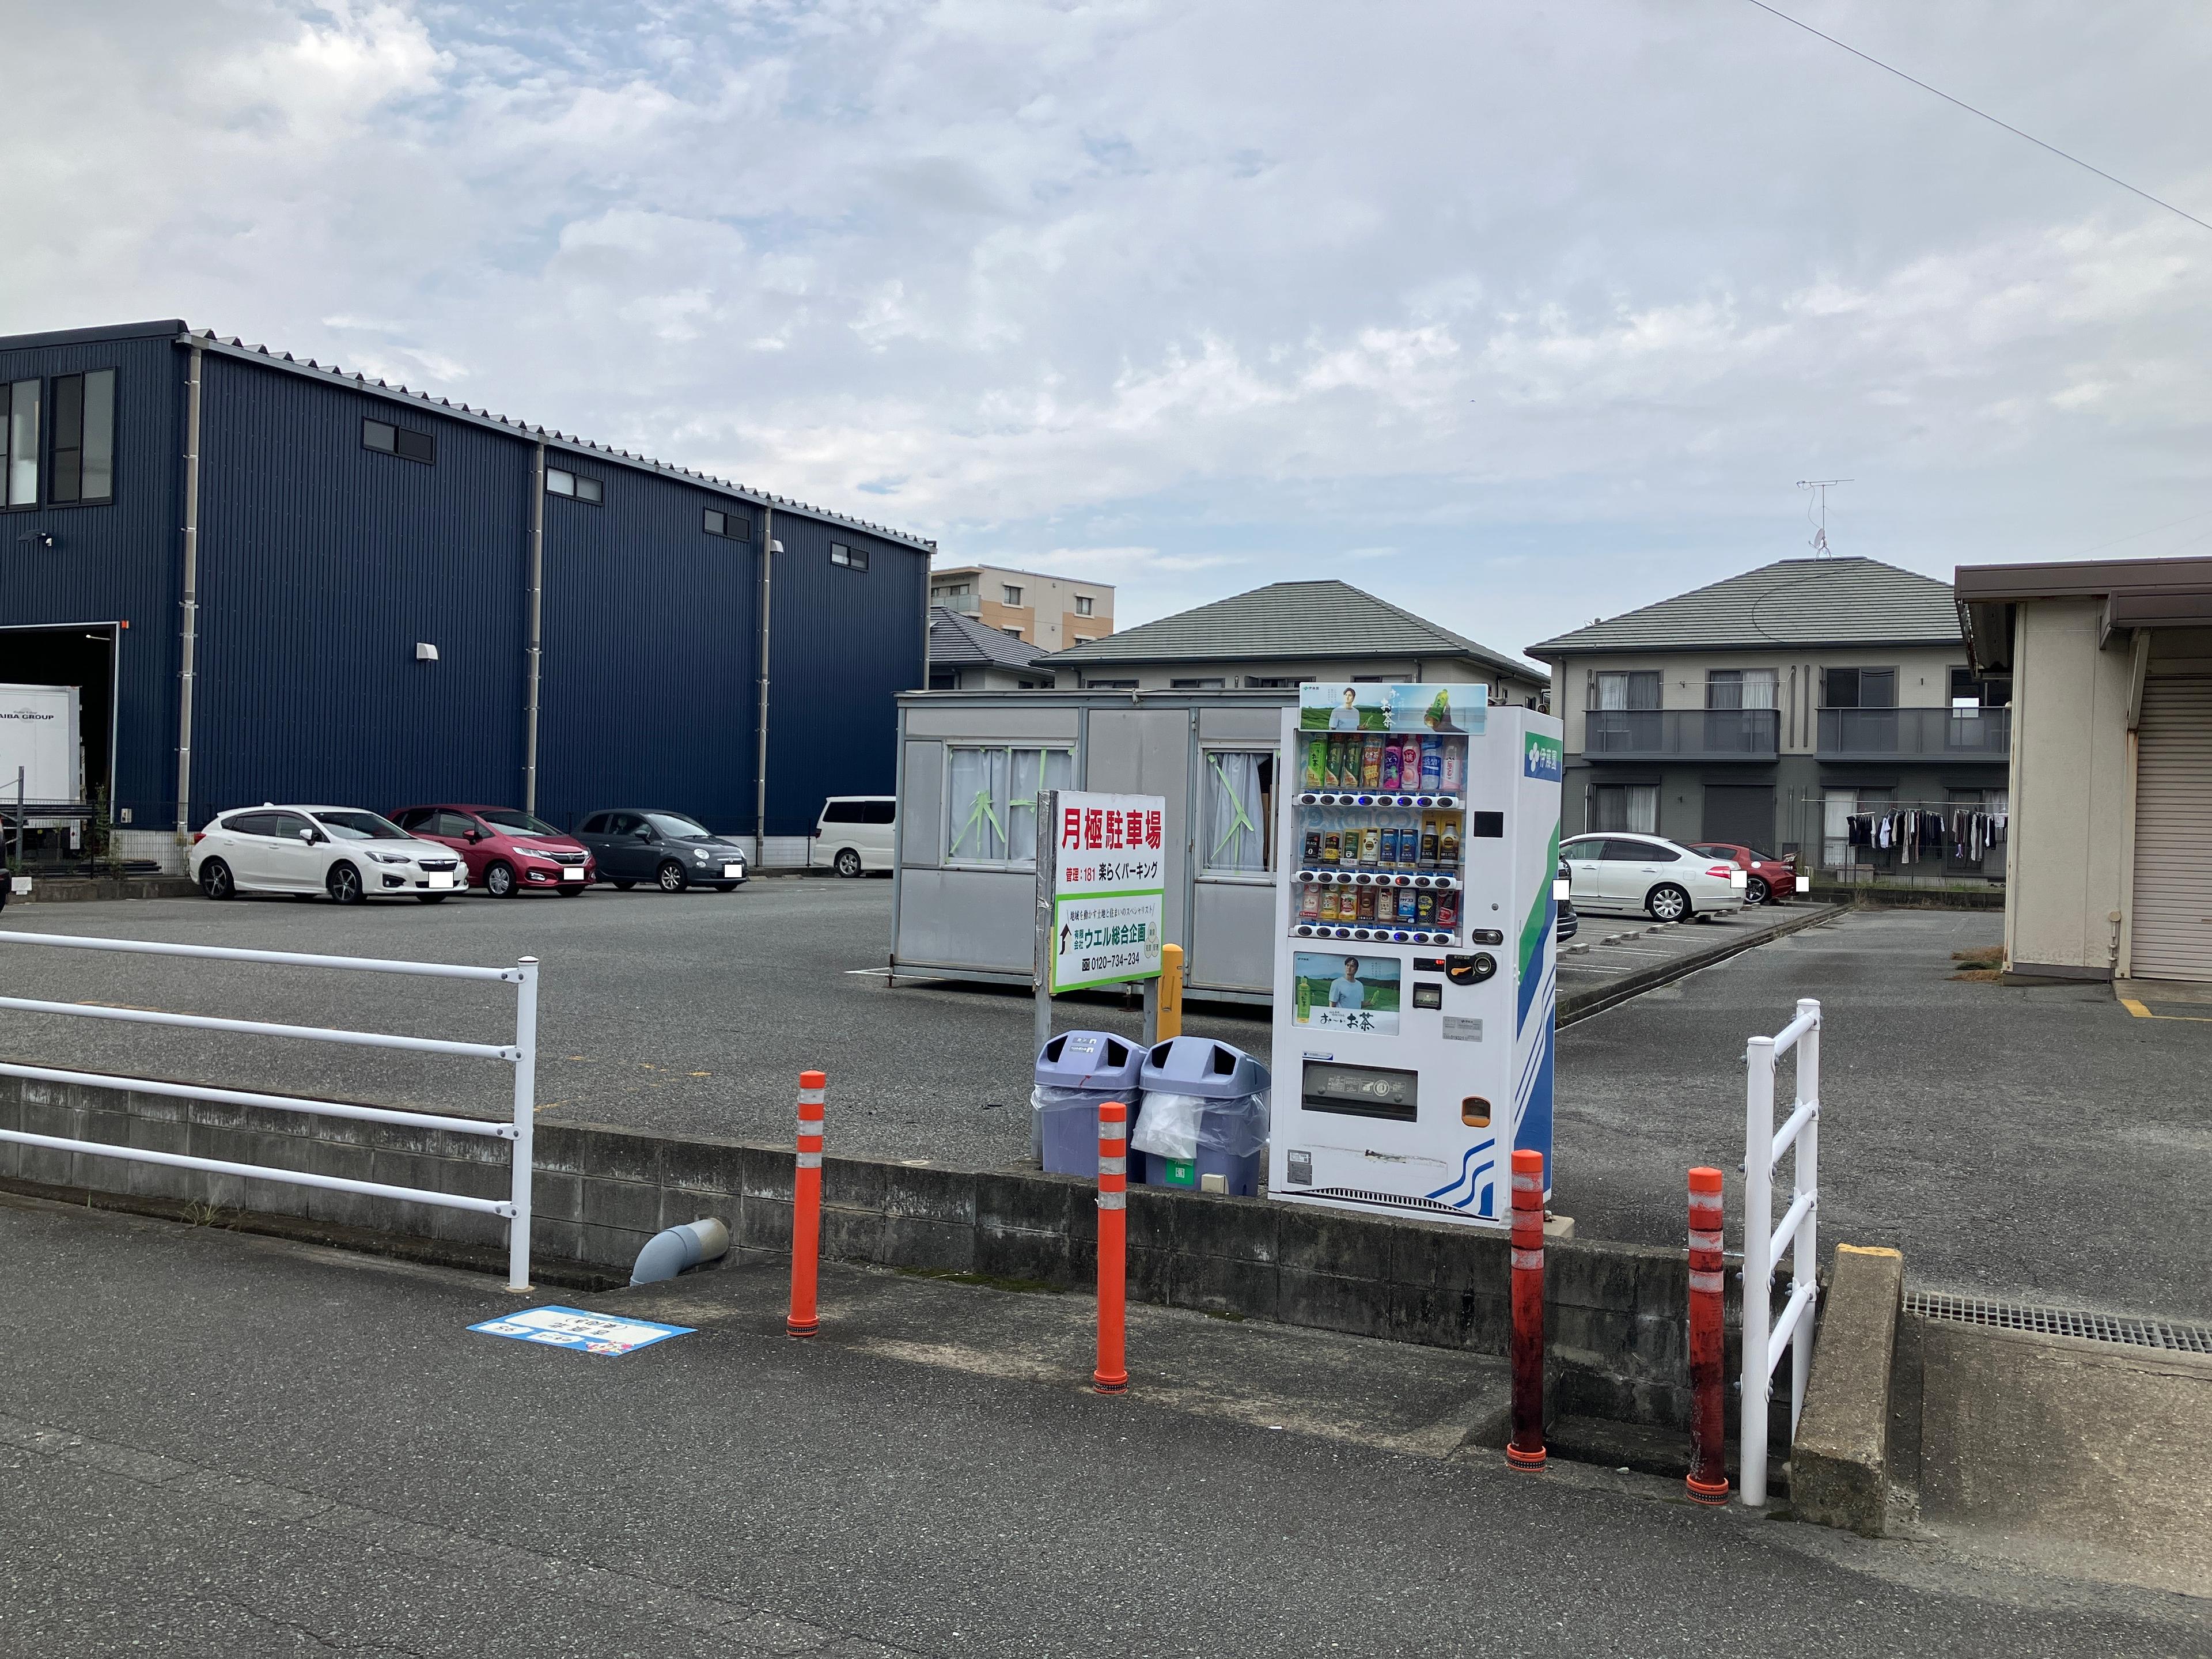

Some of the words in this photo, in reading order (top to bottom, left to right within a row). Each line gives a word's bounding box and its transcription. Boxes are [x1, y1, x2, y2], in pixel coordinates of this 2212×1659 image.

[1540, 747, 1557, 770] 伊藤園
[1062, 808, 1162, 850] 月極駐車場
[1099, 861, 1157, 881] 楽らくパーキング
[1085, 923, 1146, 949] ウエル総合企画
[1091, 952, 1139, 970] 0120-734-234
